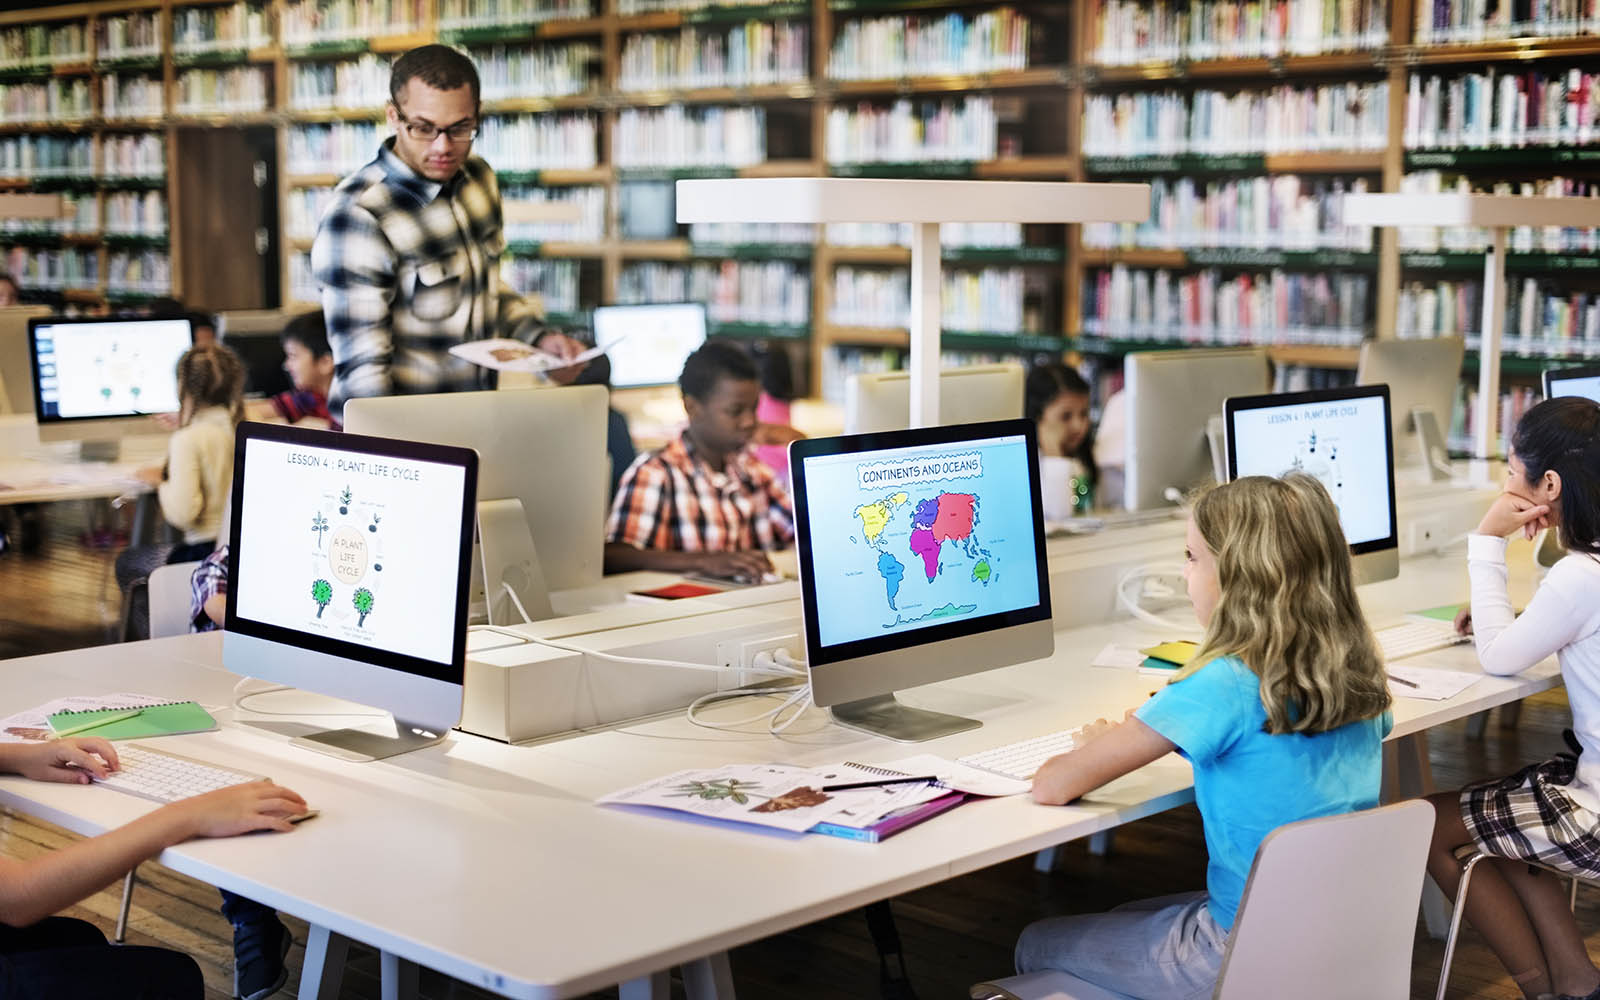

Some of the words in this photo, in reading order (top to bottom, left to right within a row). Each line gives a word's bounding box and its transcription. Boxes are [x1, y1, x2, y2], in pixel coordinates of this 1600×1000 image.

[287, 452, 320, 467] LESSON
[322, 457, 329, 468] 4
[337, 458, 366, 473] PLANT
[368, 463, 388, 477] LIFE
[391, 467, 420, 481] CYCLE
[863, 465, 920, 483] CONTINENTS
[921, 463, 941, 476] AND
[942, 459, 979, 474] OCEANS
[334, 538, 340, 546] A
[341, 538, 364, 551] PLANT
[339, 552, 356, 563] LIFE
[337, 564, 360, 577] CYCLE
